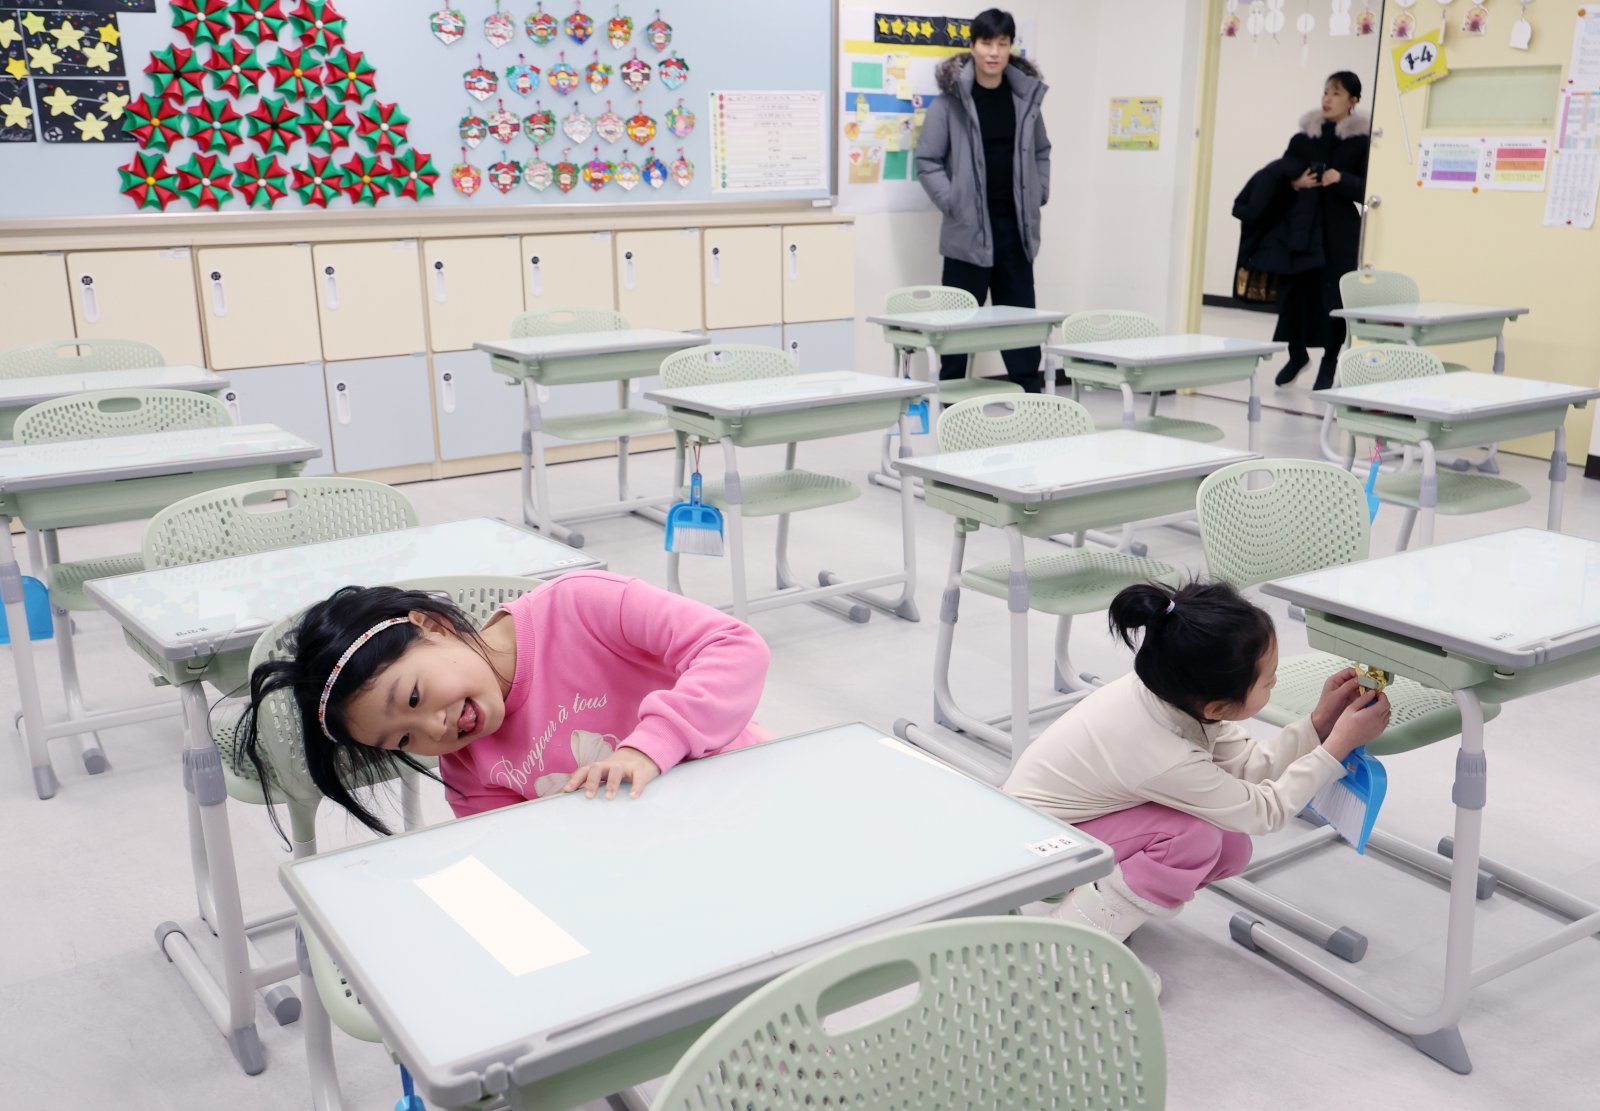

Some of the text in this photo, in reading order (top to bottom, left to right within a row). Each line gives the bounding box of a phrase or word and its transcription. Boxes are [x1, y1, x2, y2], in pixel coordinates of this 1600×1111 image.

[1405, 45, 1433, 70] 1-4
[490, 692, 608, 796] Bonjour à tous
